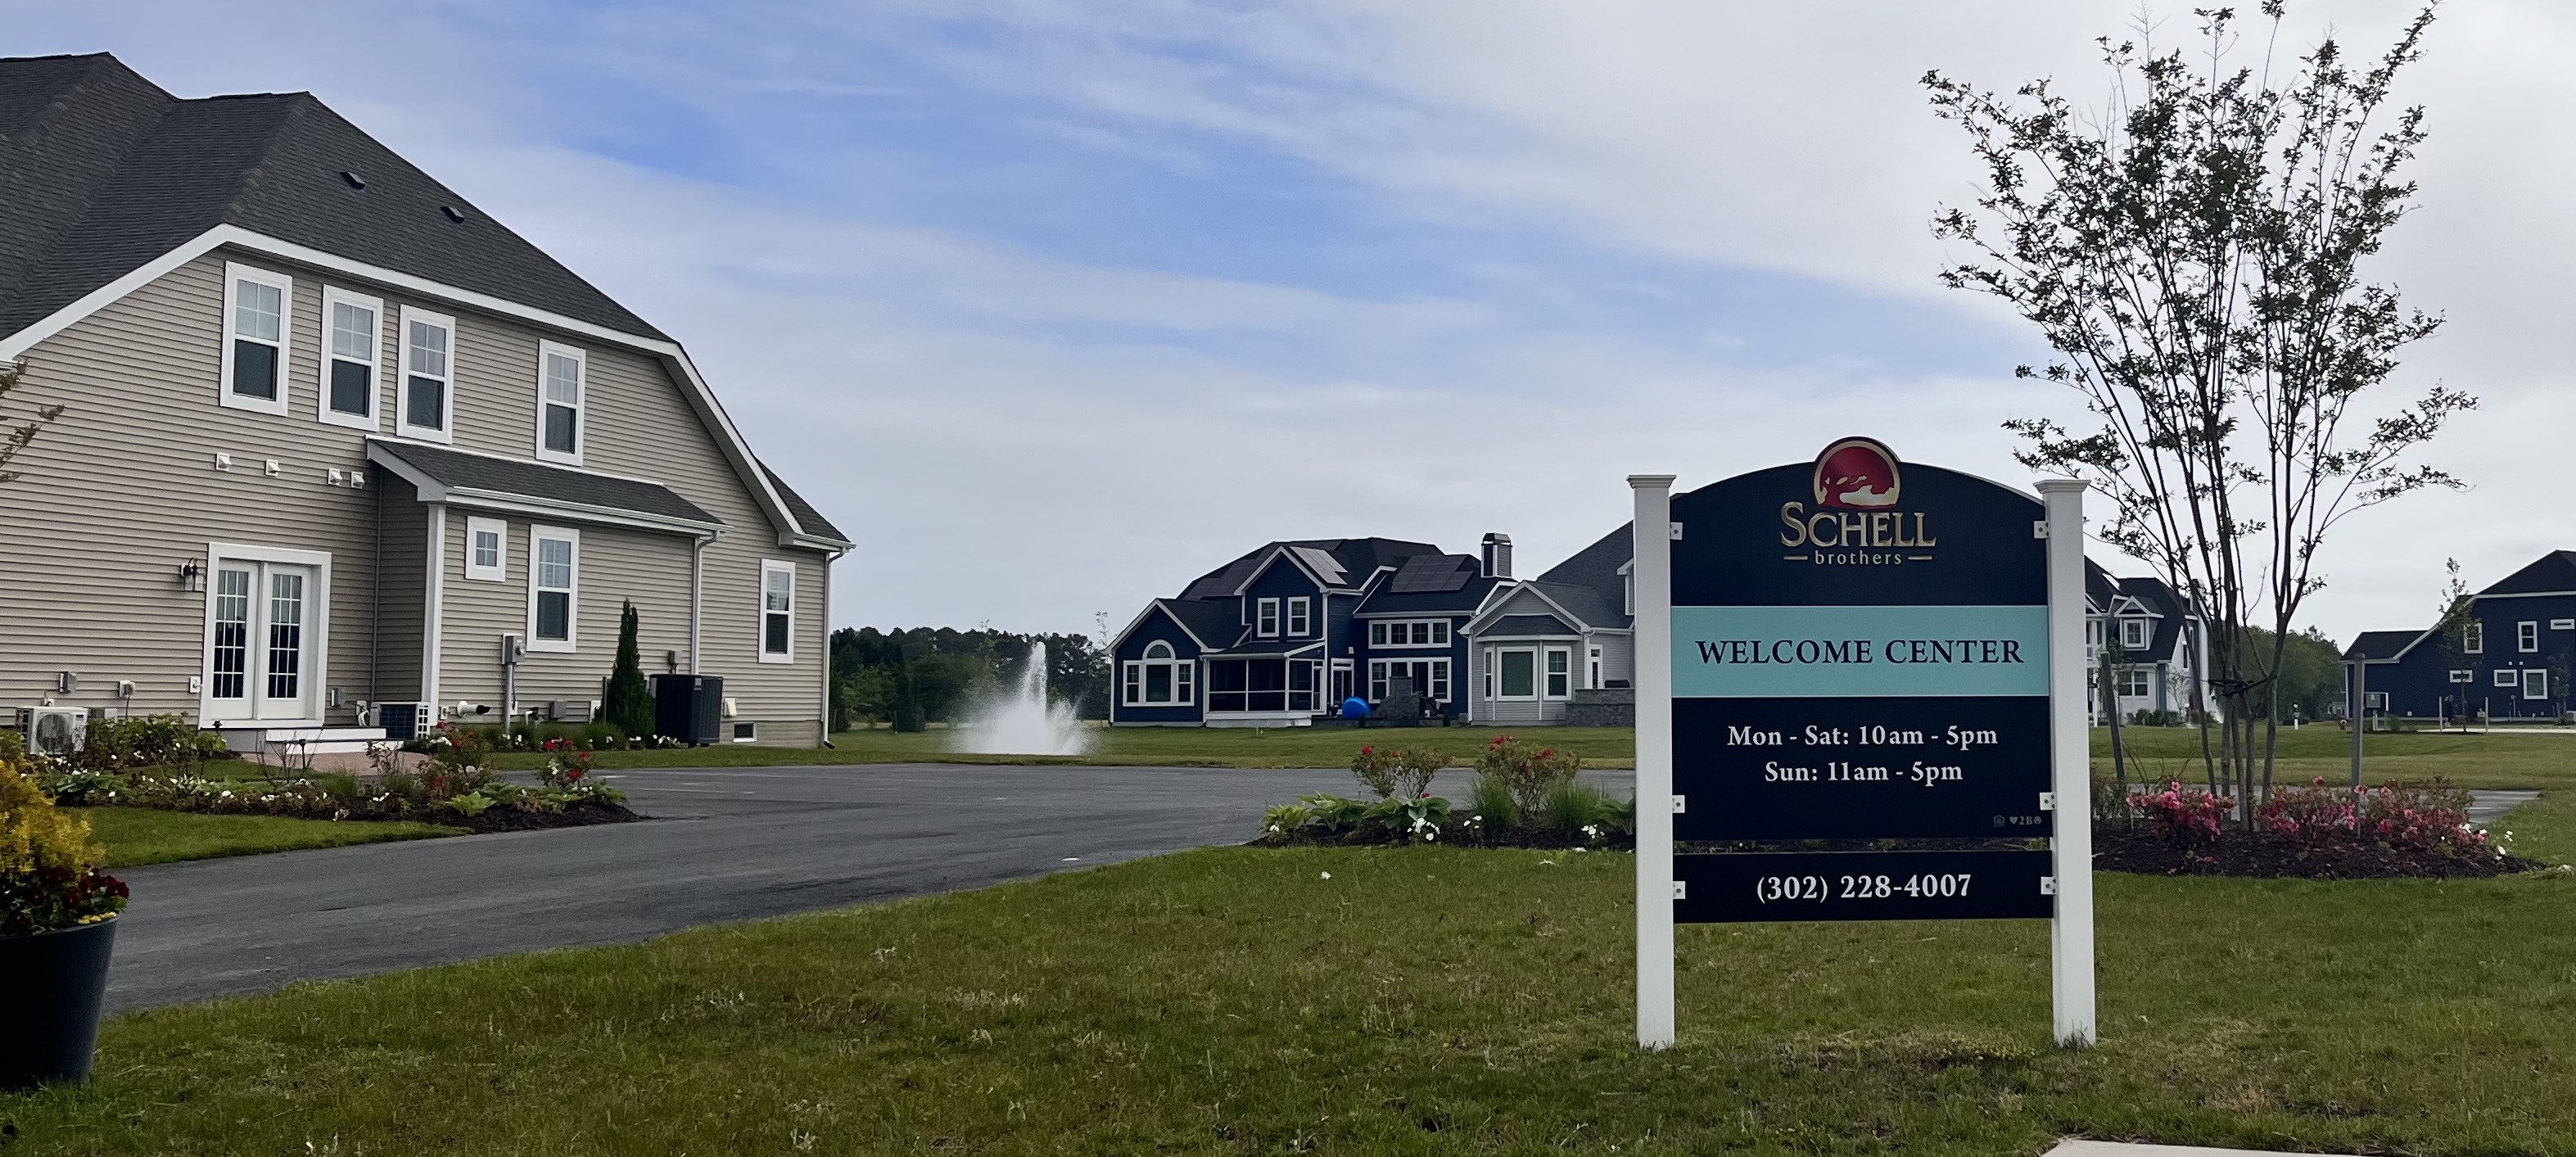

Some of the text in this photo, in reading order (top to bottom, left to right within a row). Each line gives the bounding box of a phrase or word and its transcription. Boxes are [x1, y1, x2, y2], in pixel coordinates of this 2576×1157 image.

[1780, 499, 1937, 548] SCHELL
[1814, 549, 1902, 565] brothers
[1694, 640, 2025, 664] WELCOME CENTER
[1726, 725, 1783, 746] Mon
[1805, 725, 1849, 746] Sat:
[1859, 725, 1925, 745] 10am
[1946, 725, 1999, 752] 5pm
[1765, 761, 1818, 782] Sun:
[1828, 762, 1890, 781] 11am
[1910, 761, 1964, 788] 5pm
[1756, 874, 1972, 905] (302) 228-4007
